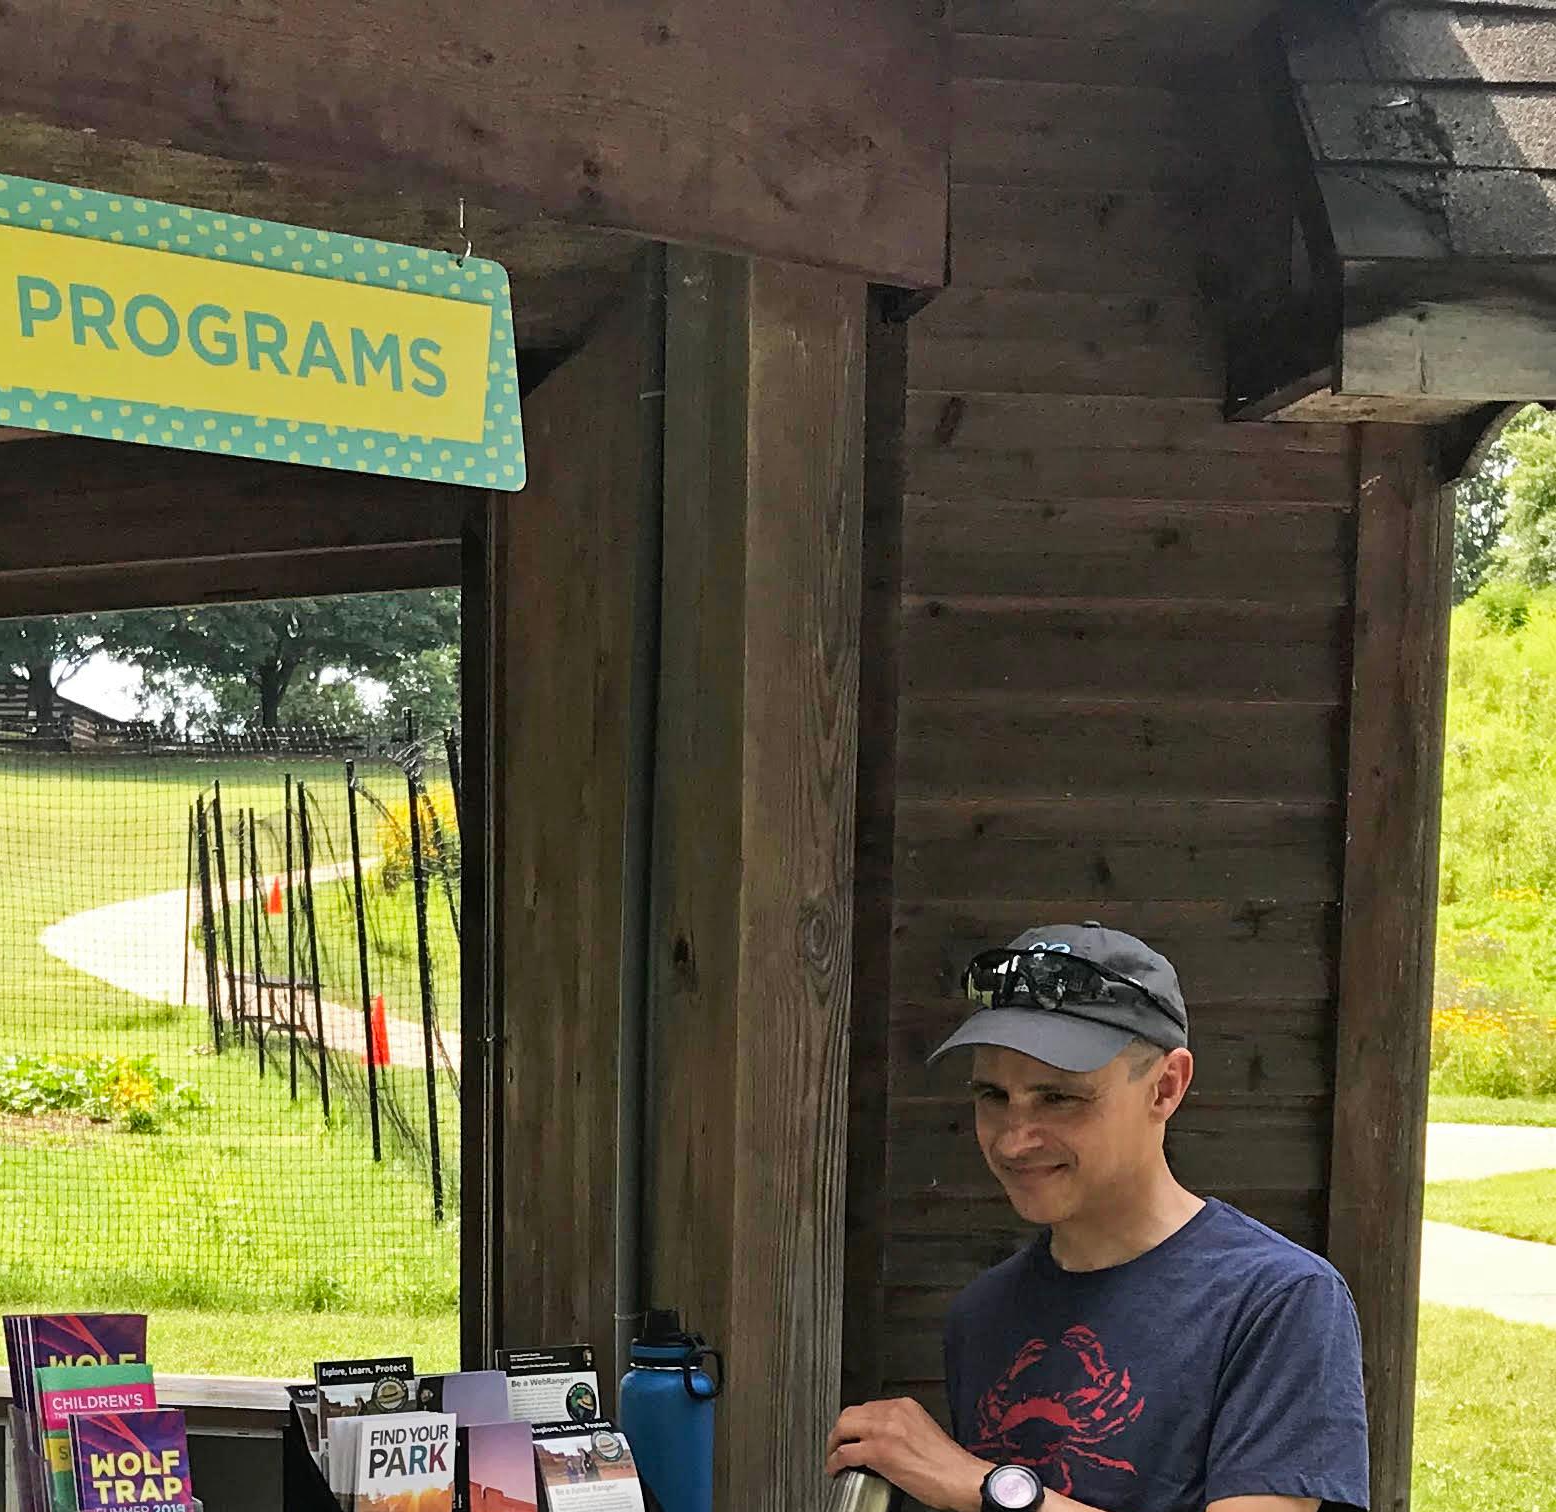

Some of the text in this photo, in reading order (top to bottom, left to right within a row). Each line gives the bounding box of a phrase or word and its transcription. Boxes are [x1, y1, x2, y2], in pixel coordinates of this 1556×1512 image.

[15, 275, 447, 399] PROGRAMS
[321, 1363, 407, 1379] Explore, Learn, Protect
[511, 1380, 522, 1388] Be
[52, 1393, 144, 1411] CHILDREN'S
[370, 1424, 449, 1447] FIND YOUR
[90, 1450, 180, 1478] WOLF
[368, 1442, 449, 1479] PARK
[92, 1477, 183, 1505] TRAP
